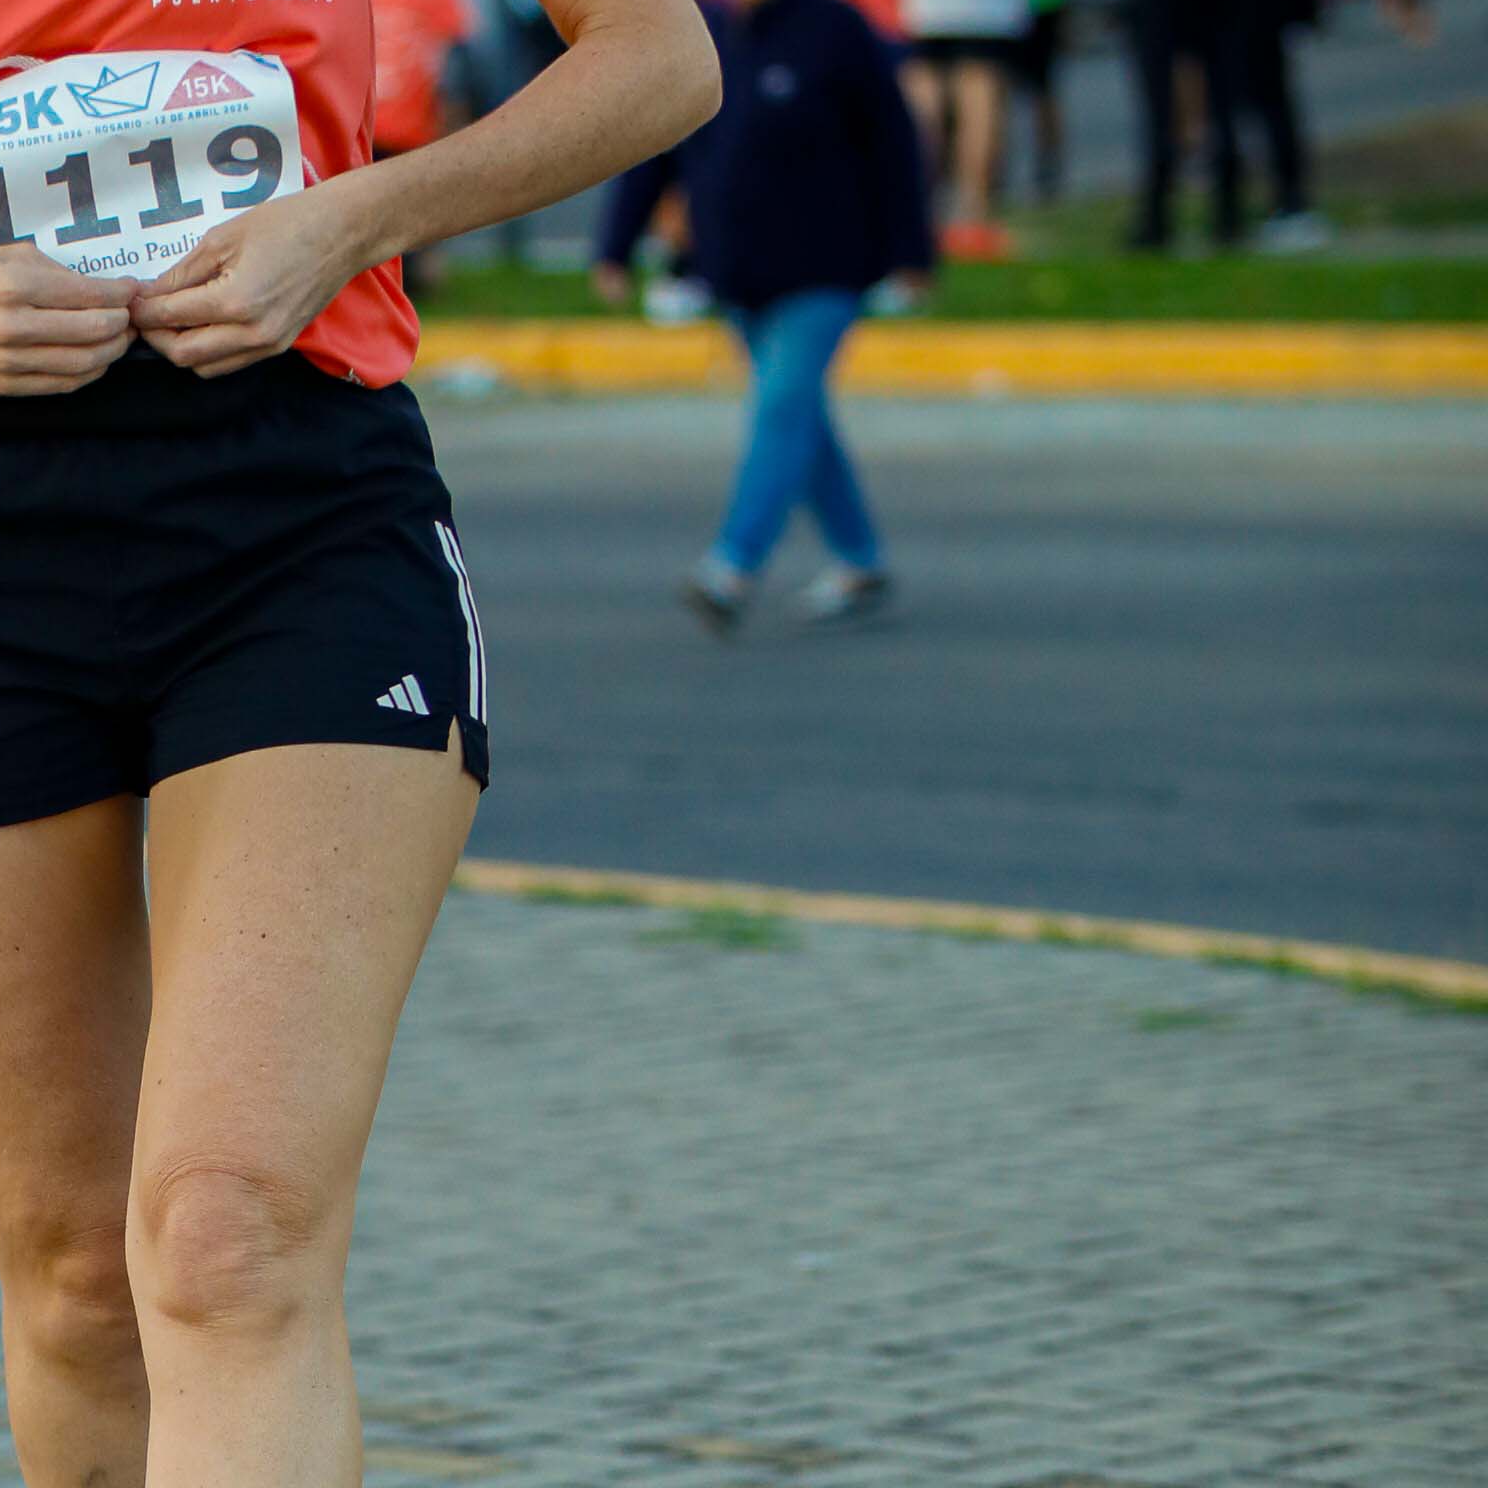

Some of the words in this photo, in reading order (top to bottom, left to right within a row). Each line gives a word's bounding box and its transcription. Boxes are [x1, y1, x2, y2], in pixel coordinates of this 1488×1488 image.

[181, 72, 231, 100] 15K
[17, 133, 53, 148] NORTE
[95, 119, 142, 134] ROSARIO
[170, 112, 183, 123] DE
[188, 108, 219, 121] ABRIL
[224, 102, 250, 113] 2026
